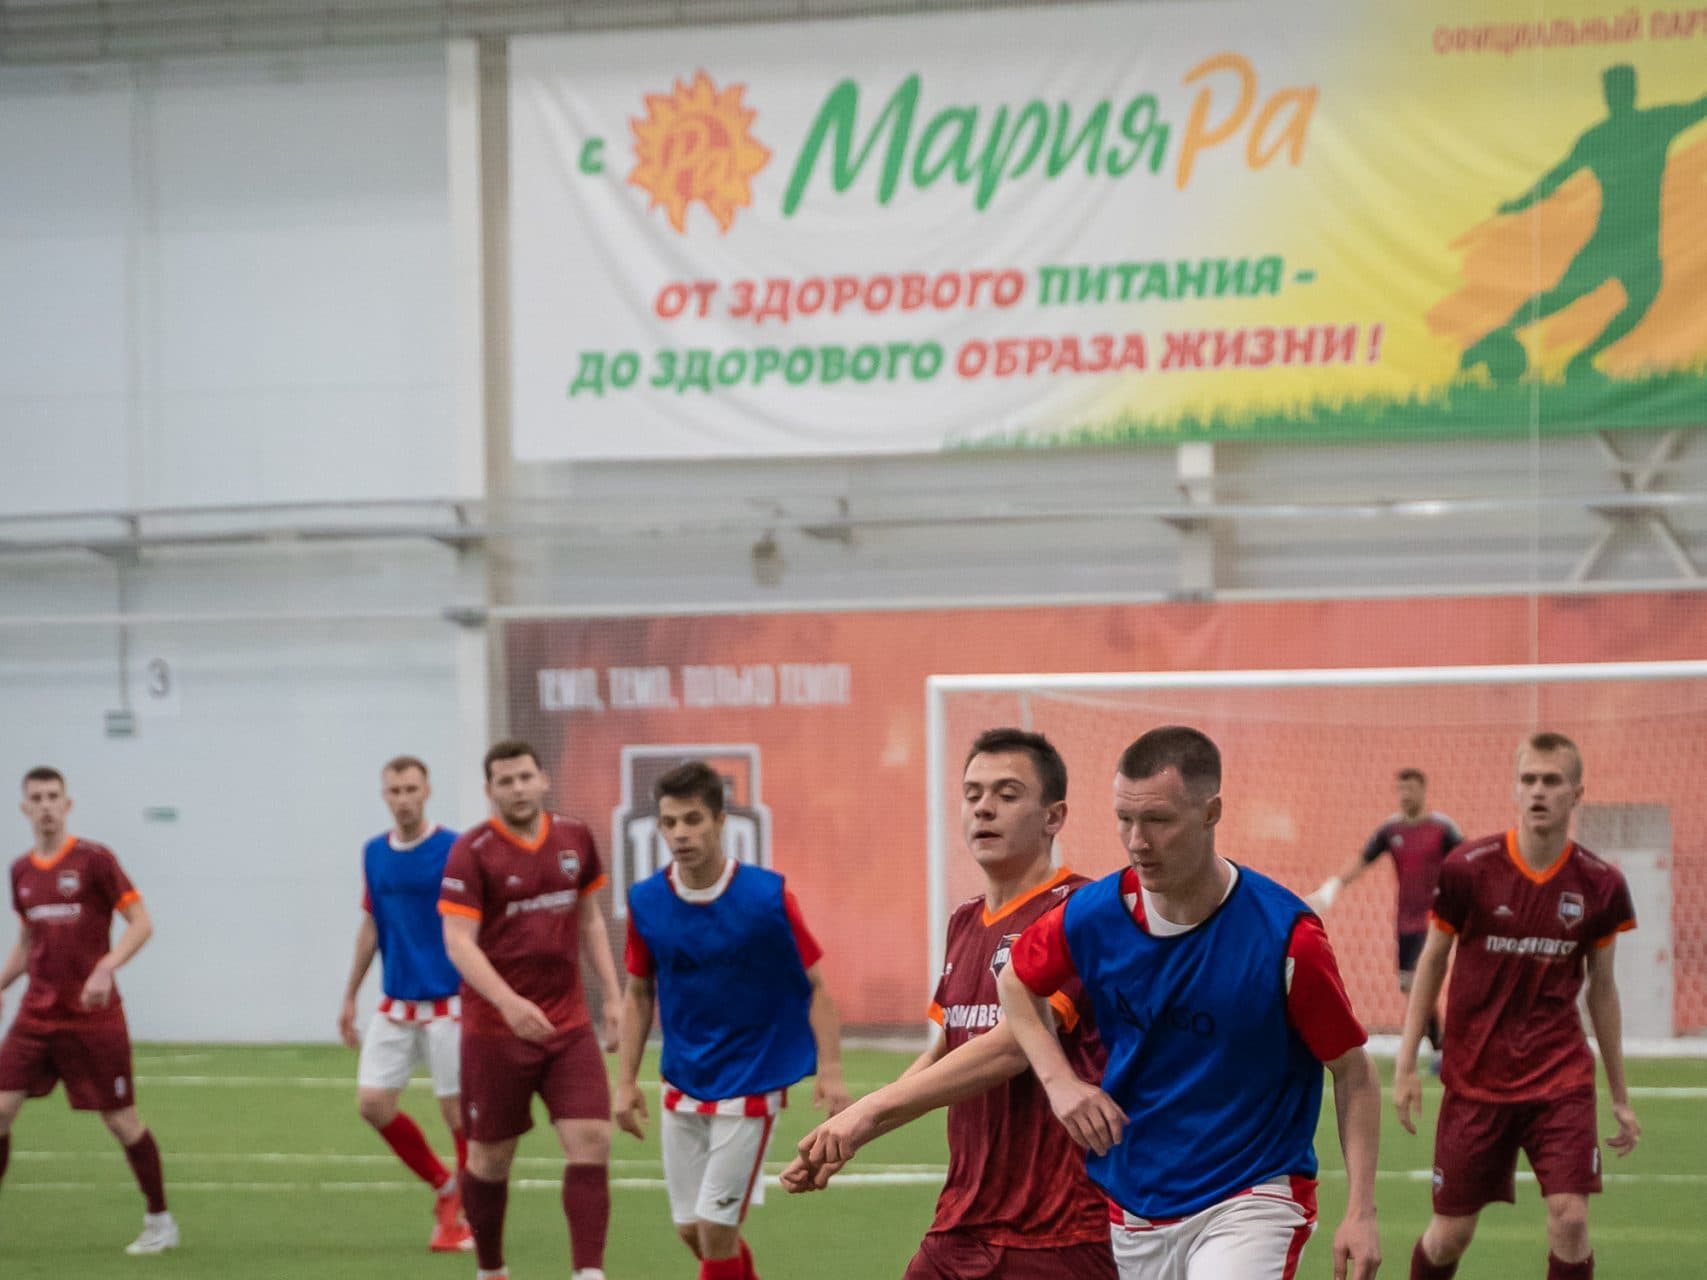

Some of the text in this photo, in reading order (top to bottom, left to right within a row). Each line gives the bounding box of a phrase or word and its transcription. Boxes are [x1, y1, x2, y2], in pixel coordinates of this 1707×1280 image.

[655, 281, 718, 320] ОТ
[729, 269, 1025, 324] ЗДОРОВОГО
[1037, 256, 1284, 307] ПИТАНИЯ
[568, 350, 640, 397] ДО
[650, 341, 944, 394] ЗДОРОВОГО
[956, 332, 1148, 379] ОБРАЗА
[149, 657, 171, 699] 3
